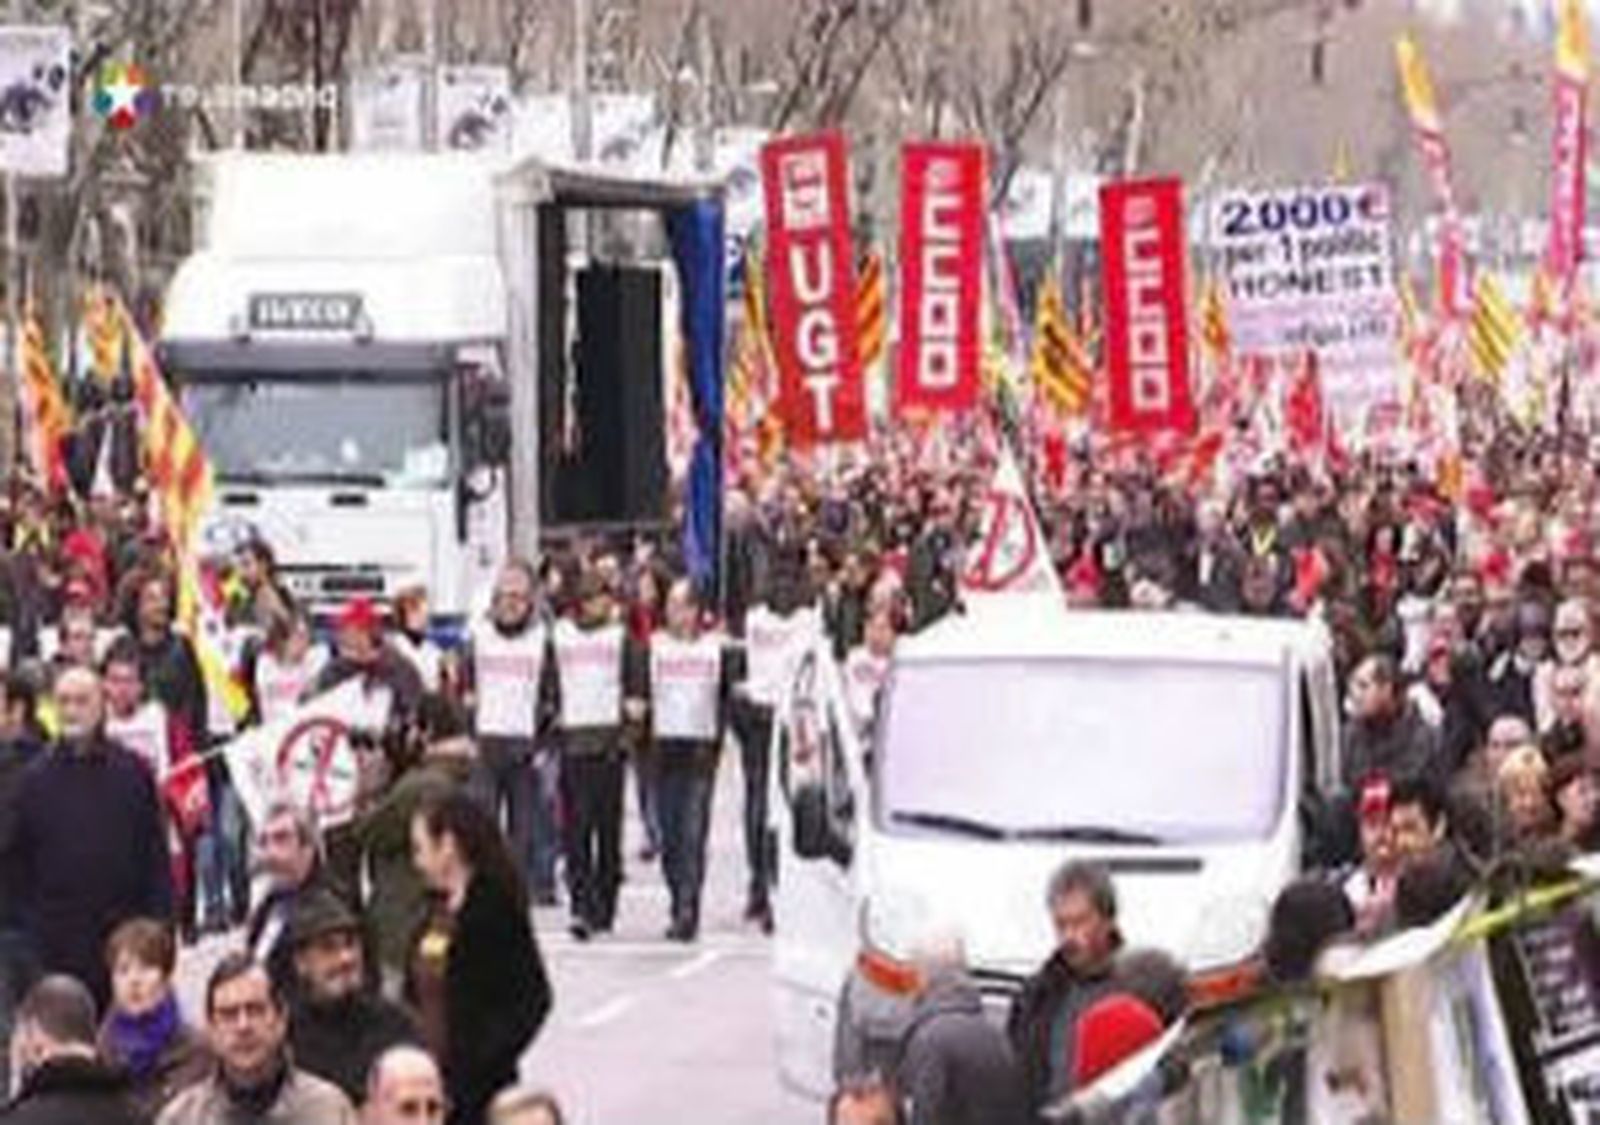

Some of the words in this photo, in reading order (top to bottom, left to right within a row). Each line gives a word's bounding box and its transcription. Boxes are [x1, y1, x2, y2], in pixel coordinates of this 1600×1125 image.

[789, 242, 842, 431] UGT
[918, 196, 961, 388] CCOO
[1125, 231, 1170, 409] CCOO
